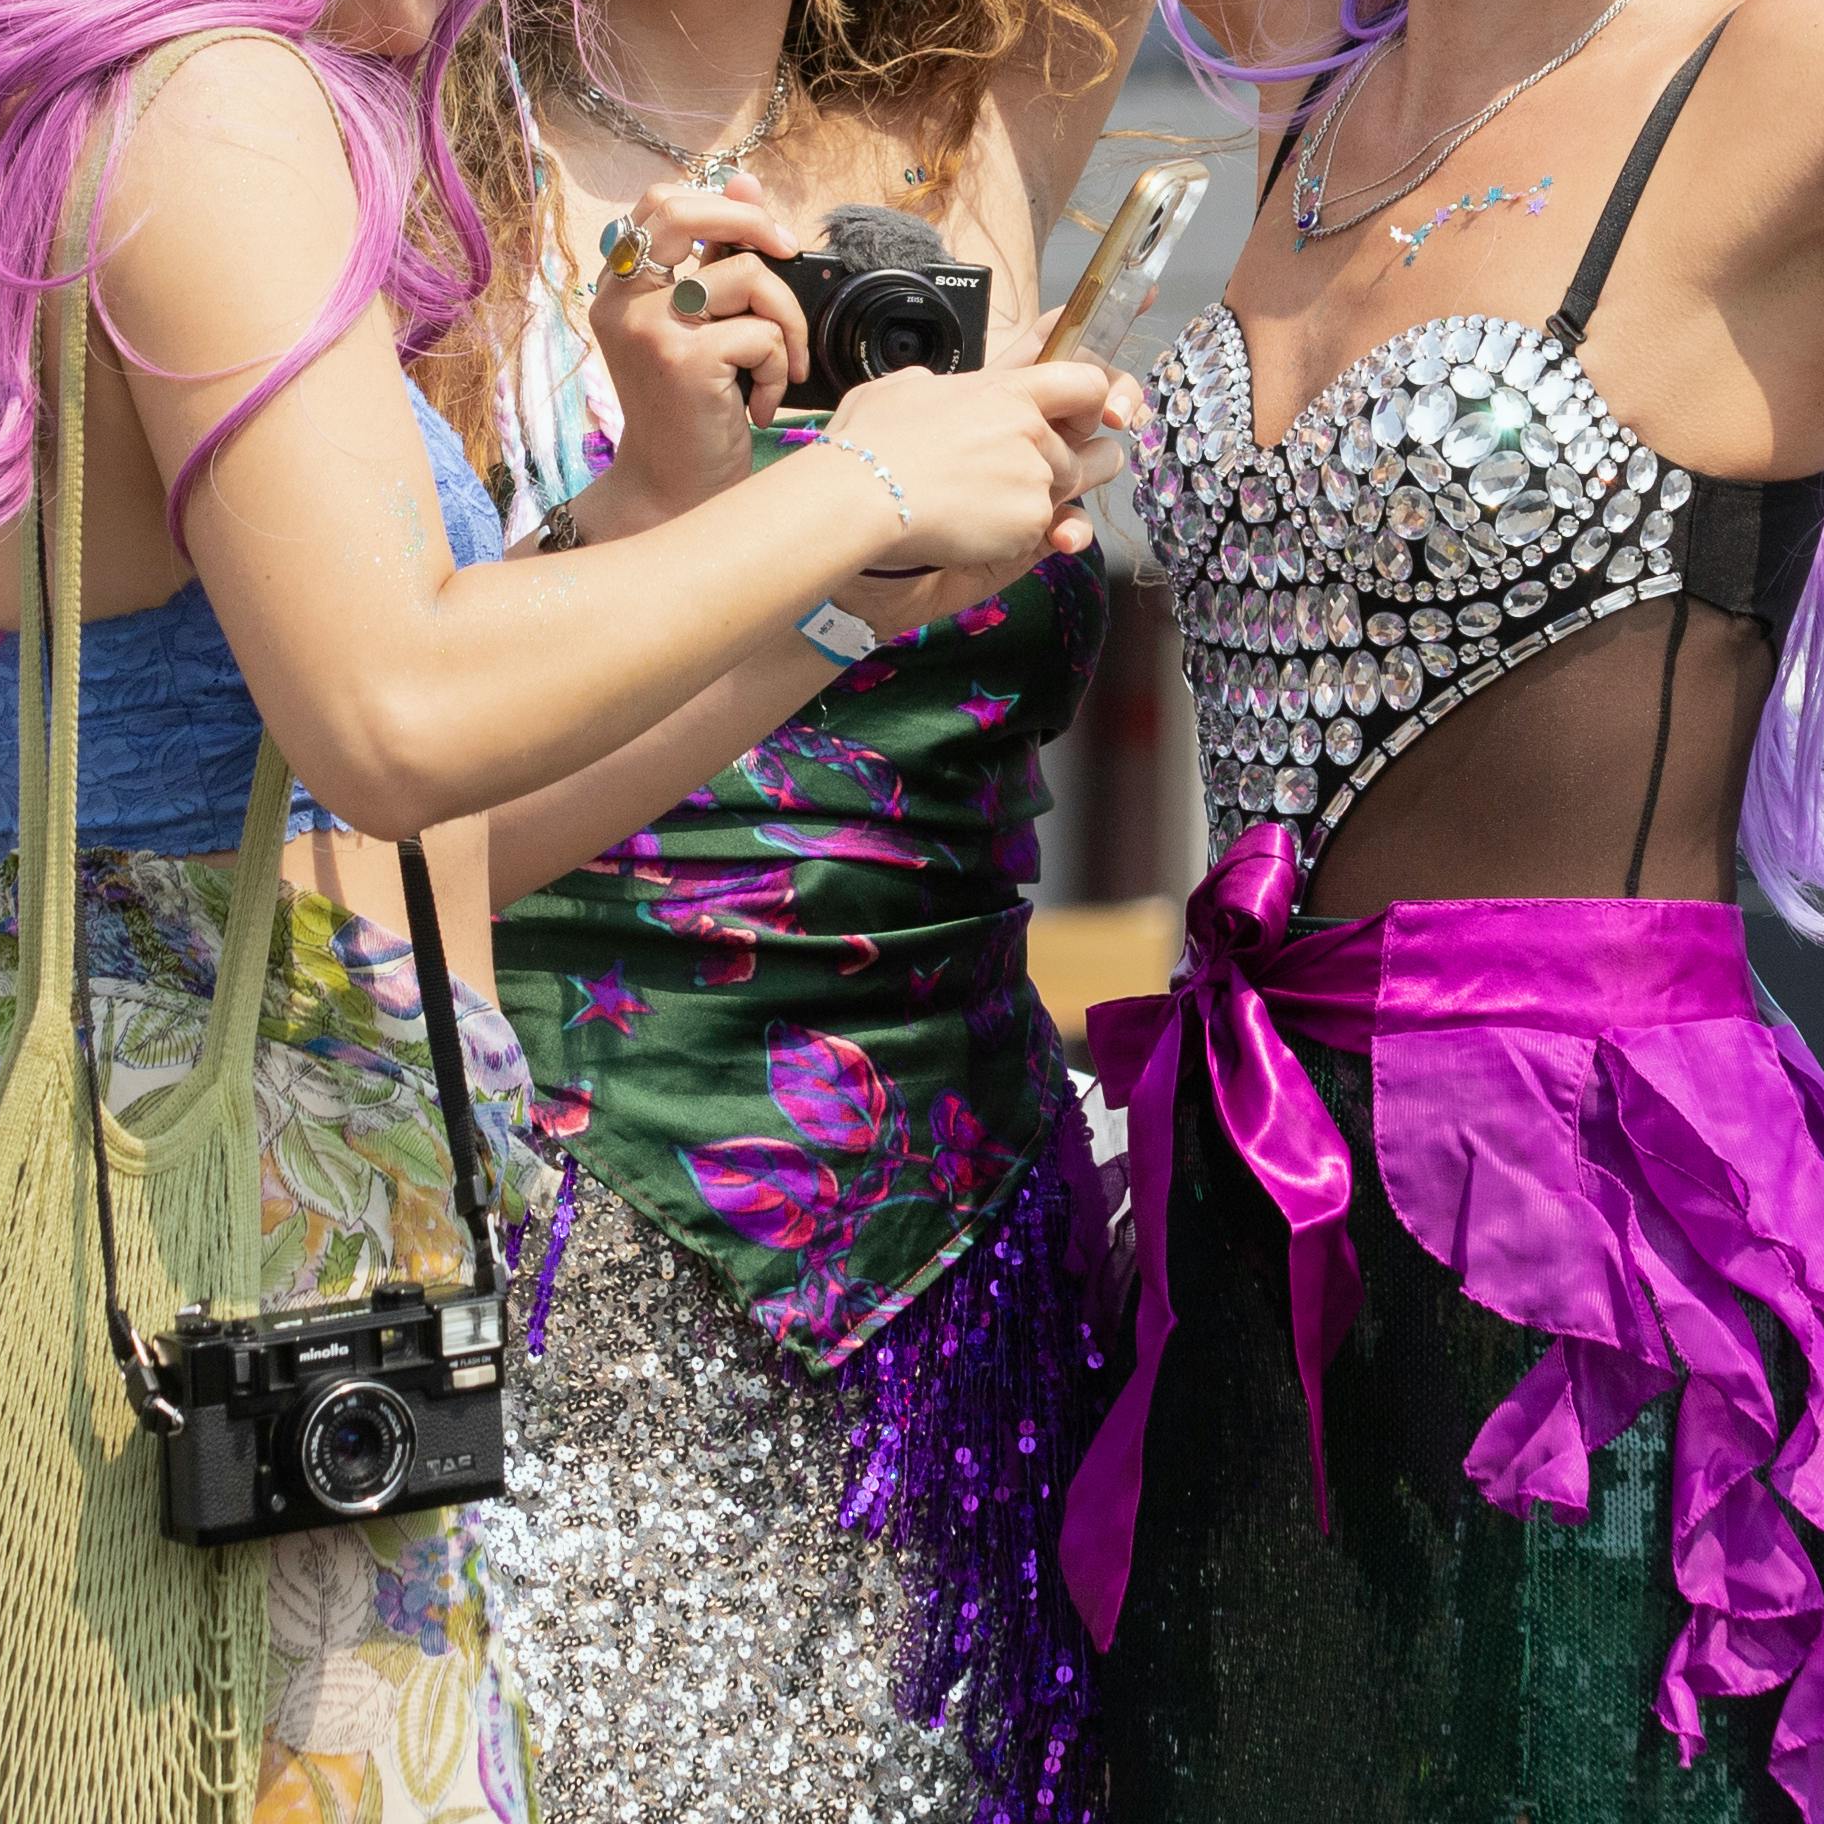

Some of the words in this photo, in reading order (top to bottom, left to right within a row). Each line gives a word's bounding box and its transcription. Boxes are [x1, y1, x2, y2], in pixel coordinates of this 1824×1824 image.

[935, 275, 980, 288] SONY
[906, 296, 924, 304] ZEISS
[299, 1342, 349, 1363] minolta
[460, 1356, 480, 1367] FLASH
